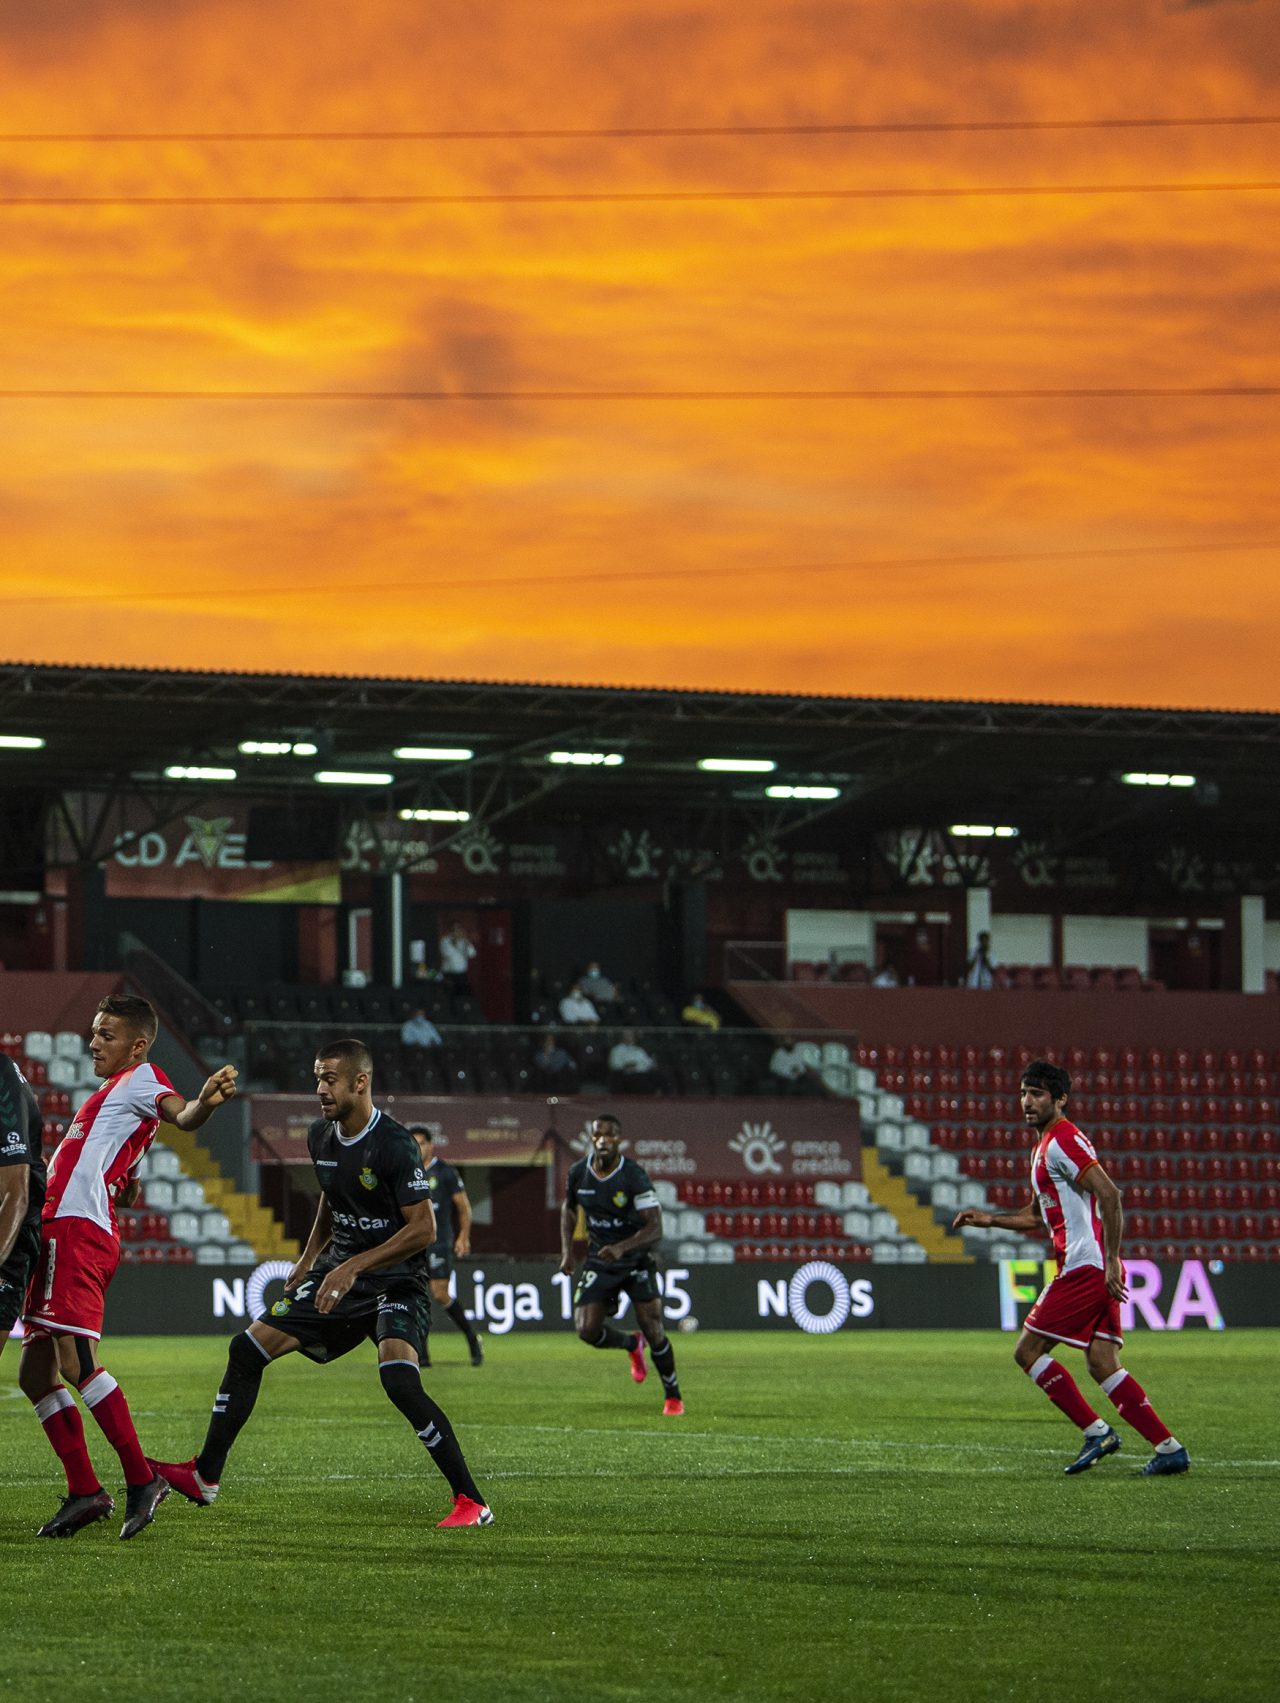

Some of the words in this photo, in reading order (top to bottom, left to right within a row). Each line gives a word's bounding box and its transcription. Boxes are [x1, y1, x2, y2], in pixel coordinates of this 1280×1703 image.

[113, 831, 167, 867] CD
[358, 1217, 389, 1230] Car
[213, 1260, 296, 1323] NO
[294, 1280, 315, 1301] 4
[757, 1260, 874, 1334] NOS
[998, 1259, 1225, 1332] FRA
